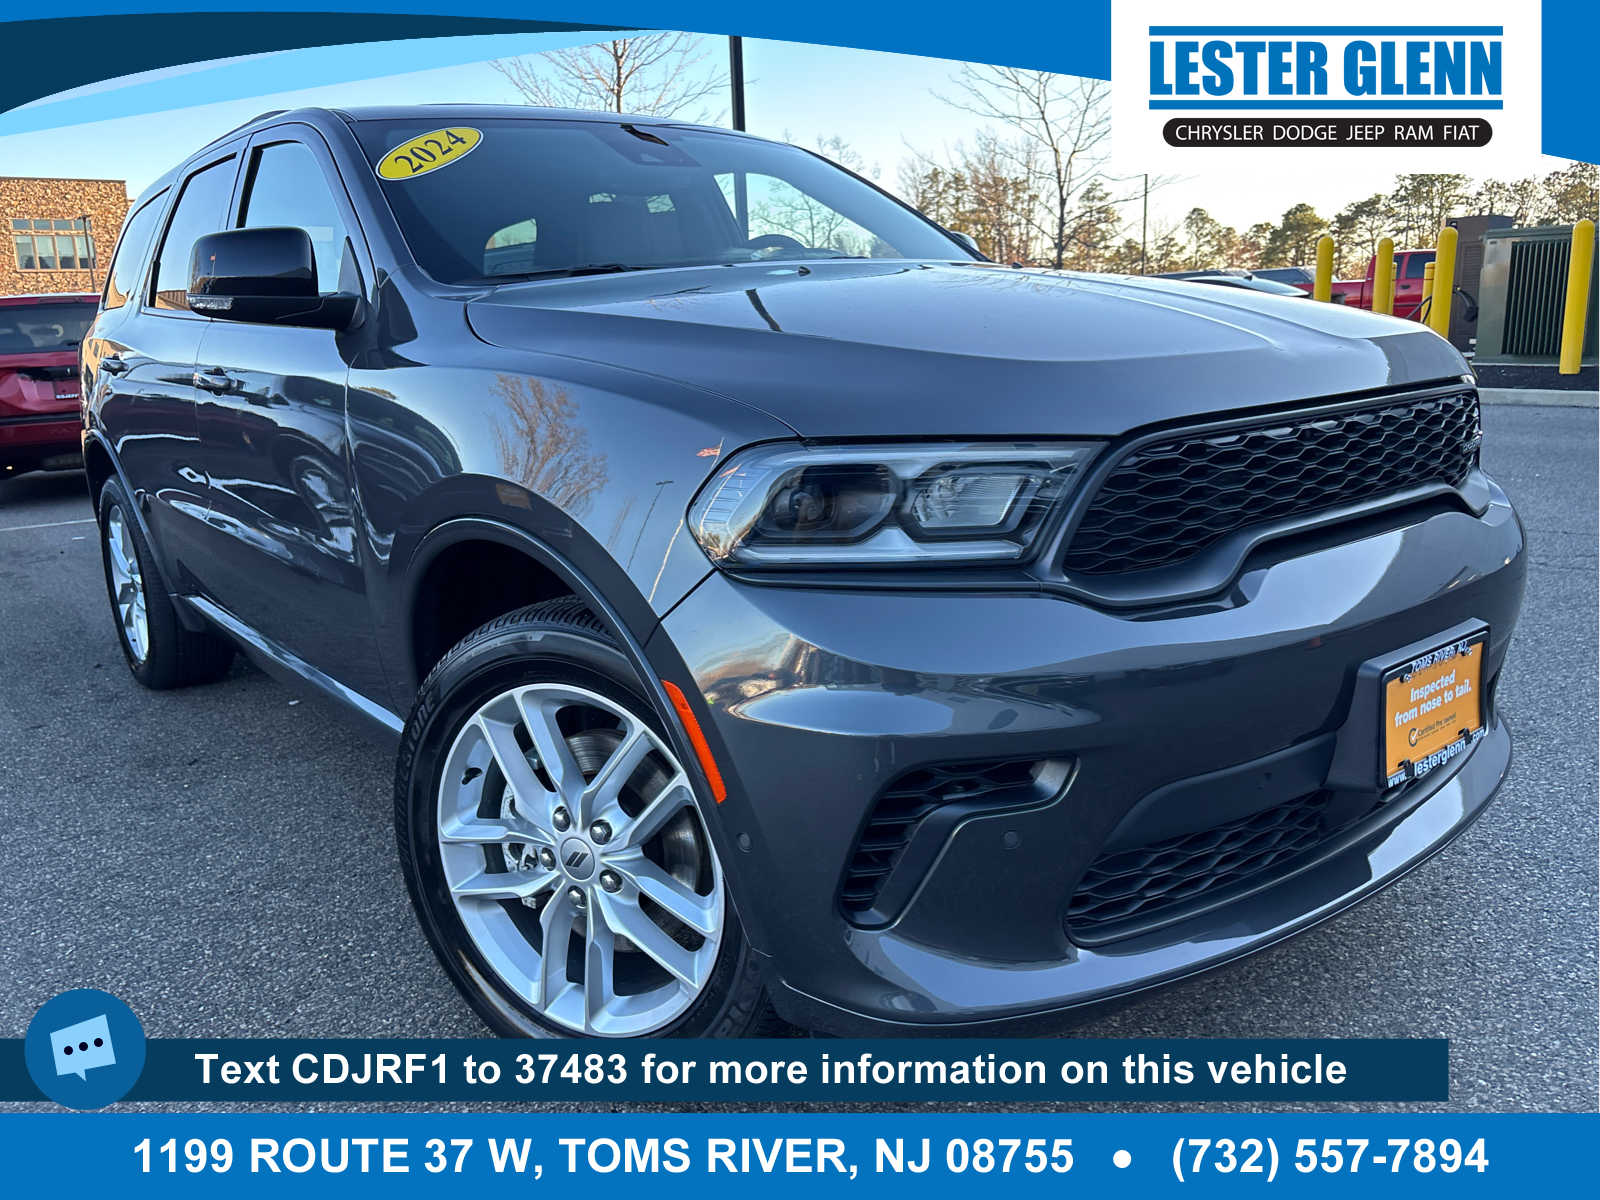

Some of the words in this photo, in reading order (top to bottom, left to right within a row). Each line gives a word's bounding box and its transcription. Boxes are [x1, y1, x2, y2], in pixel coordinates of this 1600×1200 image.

[394, 130, 467, 174] 2024
[1411, 654, 1432, 673] TOMS
[1394, 707, 1418, 729] from
[1420, 696, 1442, 716] nose
[1443, 690, 1454, 704] to
[1455, 679, 1472, 698] tail.
[1410, 668, 1456, 703] Inspected
[1414, 740, 1466, 777] lesterglenn
